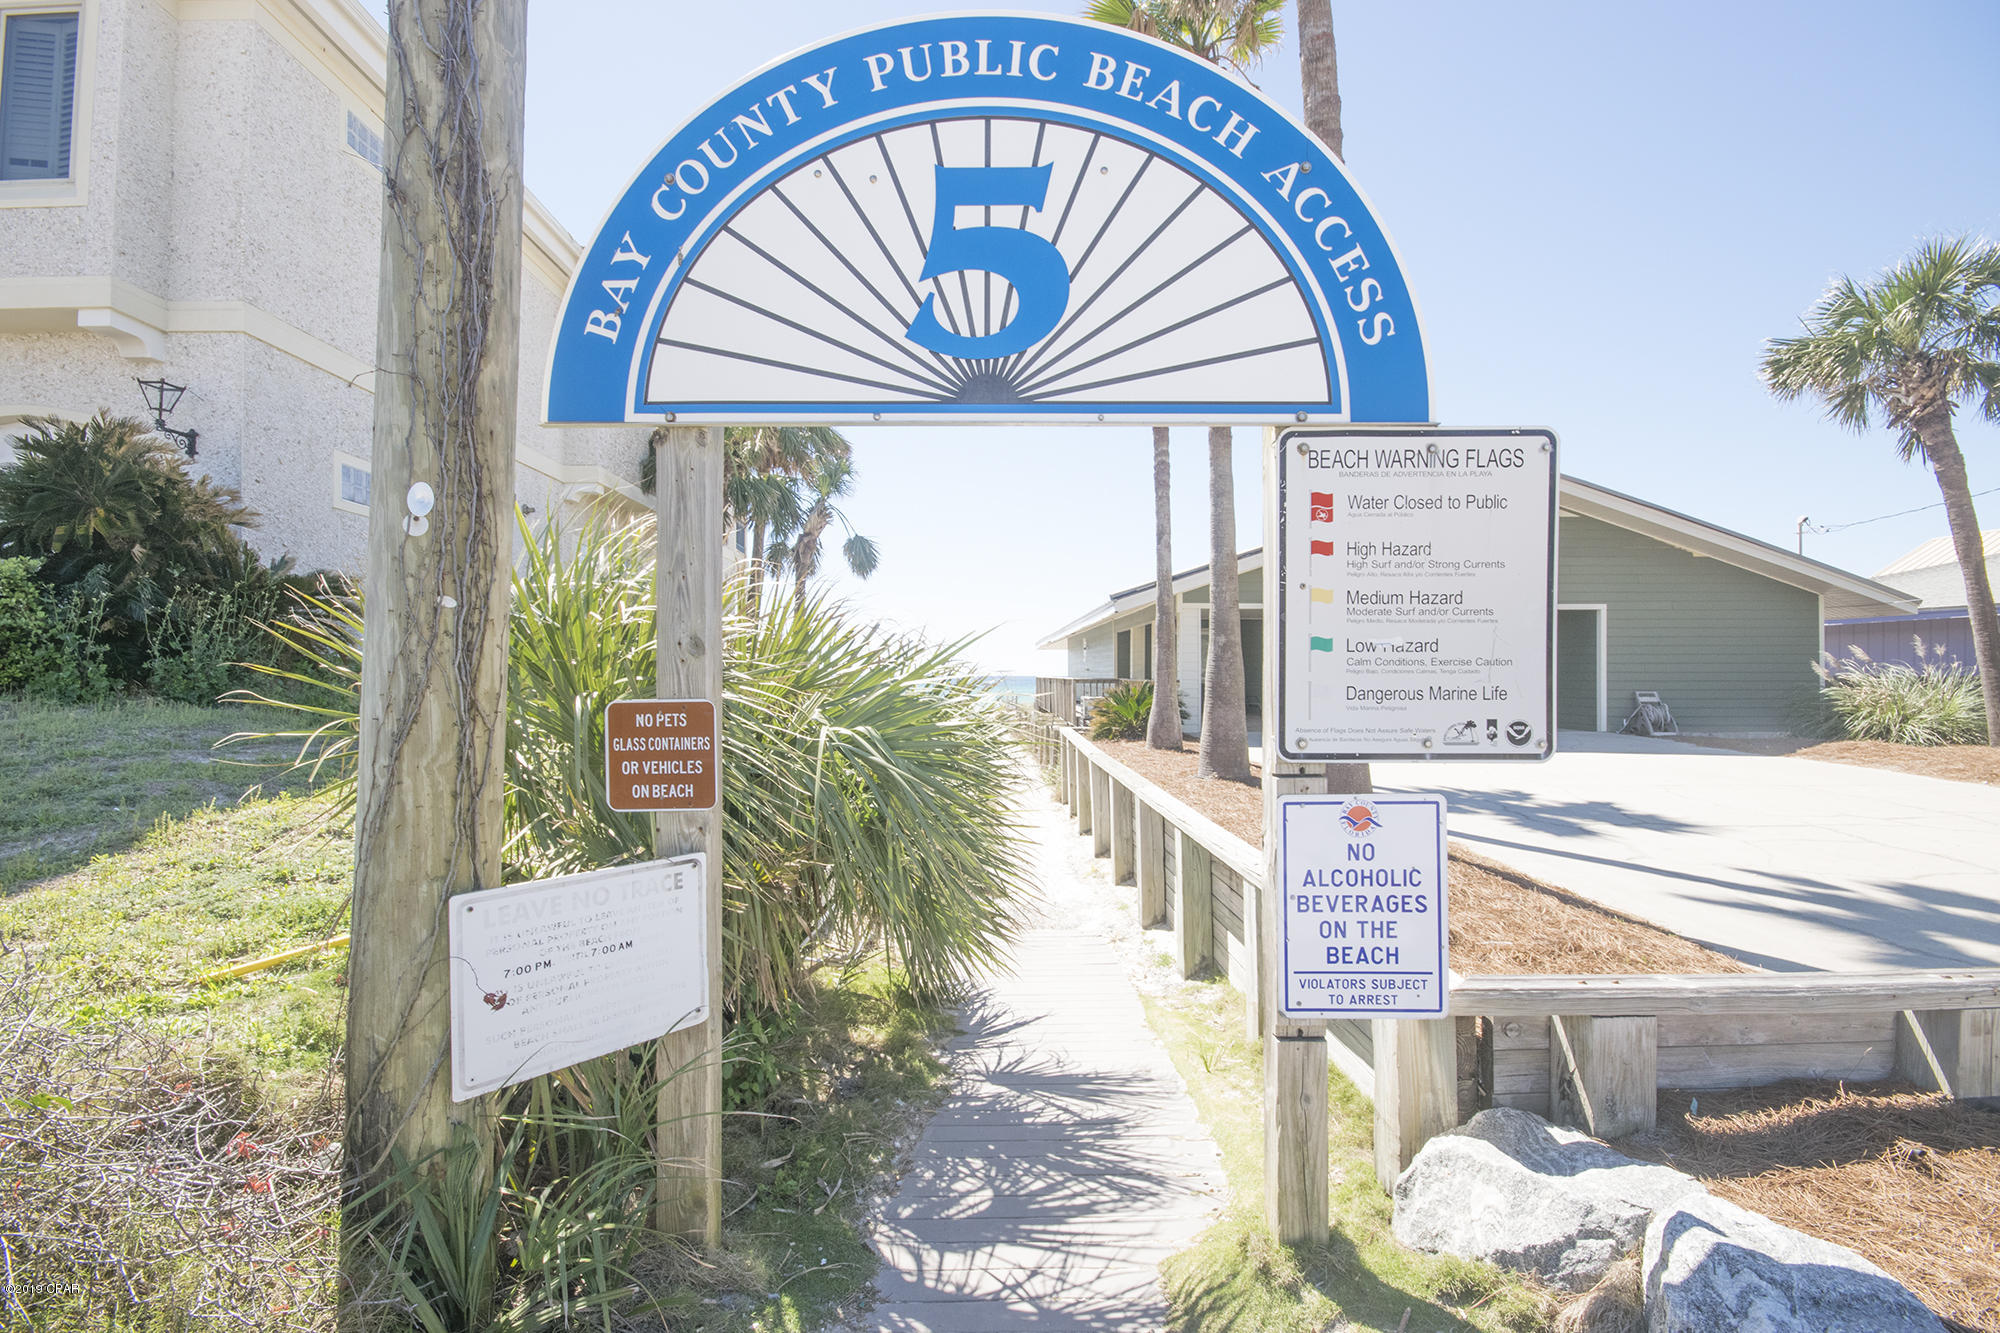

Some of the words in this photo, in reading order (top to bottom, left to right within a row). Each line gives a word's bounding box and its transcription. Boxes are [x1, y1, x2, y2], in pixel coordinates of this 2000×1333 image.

[584, 230, 651, 344] BAY
[651, 66, 839, 220] COUNTY
[862, 39, 1060, 92] PUBLIC
[1082, 51, 1261, 159] BEACH
[1261, 161, 1396, 347] ACCESS
[905, 161, 1071, 360] 5
[1308, 449, 1369, 469] BEACH
[1375, 449, 1460, 469] WARNING
[1466, 449, 1524, 468] FLAGS
[1348, 495, 1389, 509] Water
[1394, 495, 1442, 509] Closed
[1448, 496, 1460, 509] to
[1466, 494, 1507, 509] Public
[1347, 542, 1376, 560] High
[1382, 542, 1431, 556] Hazard
[1347, 559, 1368, 570] High
[1371, 560, 1392, 568] Surf
[1394, 559, 1426, 569] and/or
[1428, 560, 1460, 571] Strong
[1464, 560, 1505, 568] Currents
[1347, 590, 1403, 605] Medium
[1410, 591, 1463, 605] Hazard
[1347, 607, 1394, 616] Moderate
[1395, 607, 1418, 616] Surf
[1419, 607, 1449, 616] and/or
[1452, 607, 1495, 616] Currents
[1346, 638, 1376, 653] Low
[1347, 657, 1371, 666] Calm
[1431, 657, 1472, 666] Exercise
[1476, 657, 1512, 666] Caution
[1347, 686, 1424, 704] Dangerous
[1430, 686, 1477, 700] Marine
[1483, 686, 1507, 700] Life
[635, 713, 653, 727] NO
[656, 713, 687, 727] PETS
[613, 738, 646, 751] GLASS
[648, 736, 710, 751] CONTAINERS
[622, 761, 639, 775] OR
[642, 760, 703, 775] VEHICLES
[632, 784, 649, 798] ON
[652, 784, 694, 798] BEACH
[1348, 843, 1374, 861] NO
[1302, 869, 1422, 888] ALCOHOLIC
[1296, 895, 1428, 913] BEVERAGES
[1320, 921, 1346, 939] ON
[1357, 921, 1397, 938] THE
[591, 944, 616, 957] 7:00
[617, 940, 634, 953] AM
[1327, 947, 1398, 964] BEACH
[503, 964, 531, 979] 7:00
[534, 959, 552, 972] PM
[1299, 979, 1366, 989] VIOLATORS
[1372, 979, 1428, 990] SUBJECT
[1329, 994, 1343, 1005] TO
[1349, 995, 1397, 1005] ARREST
